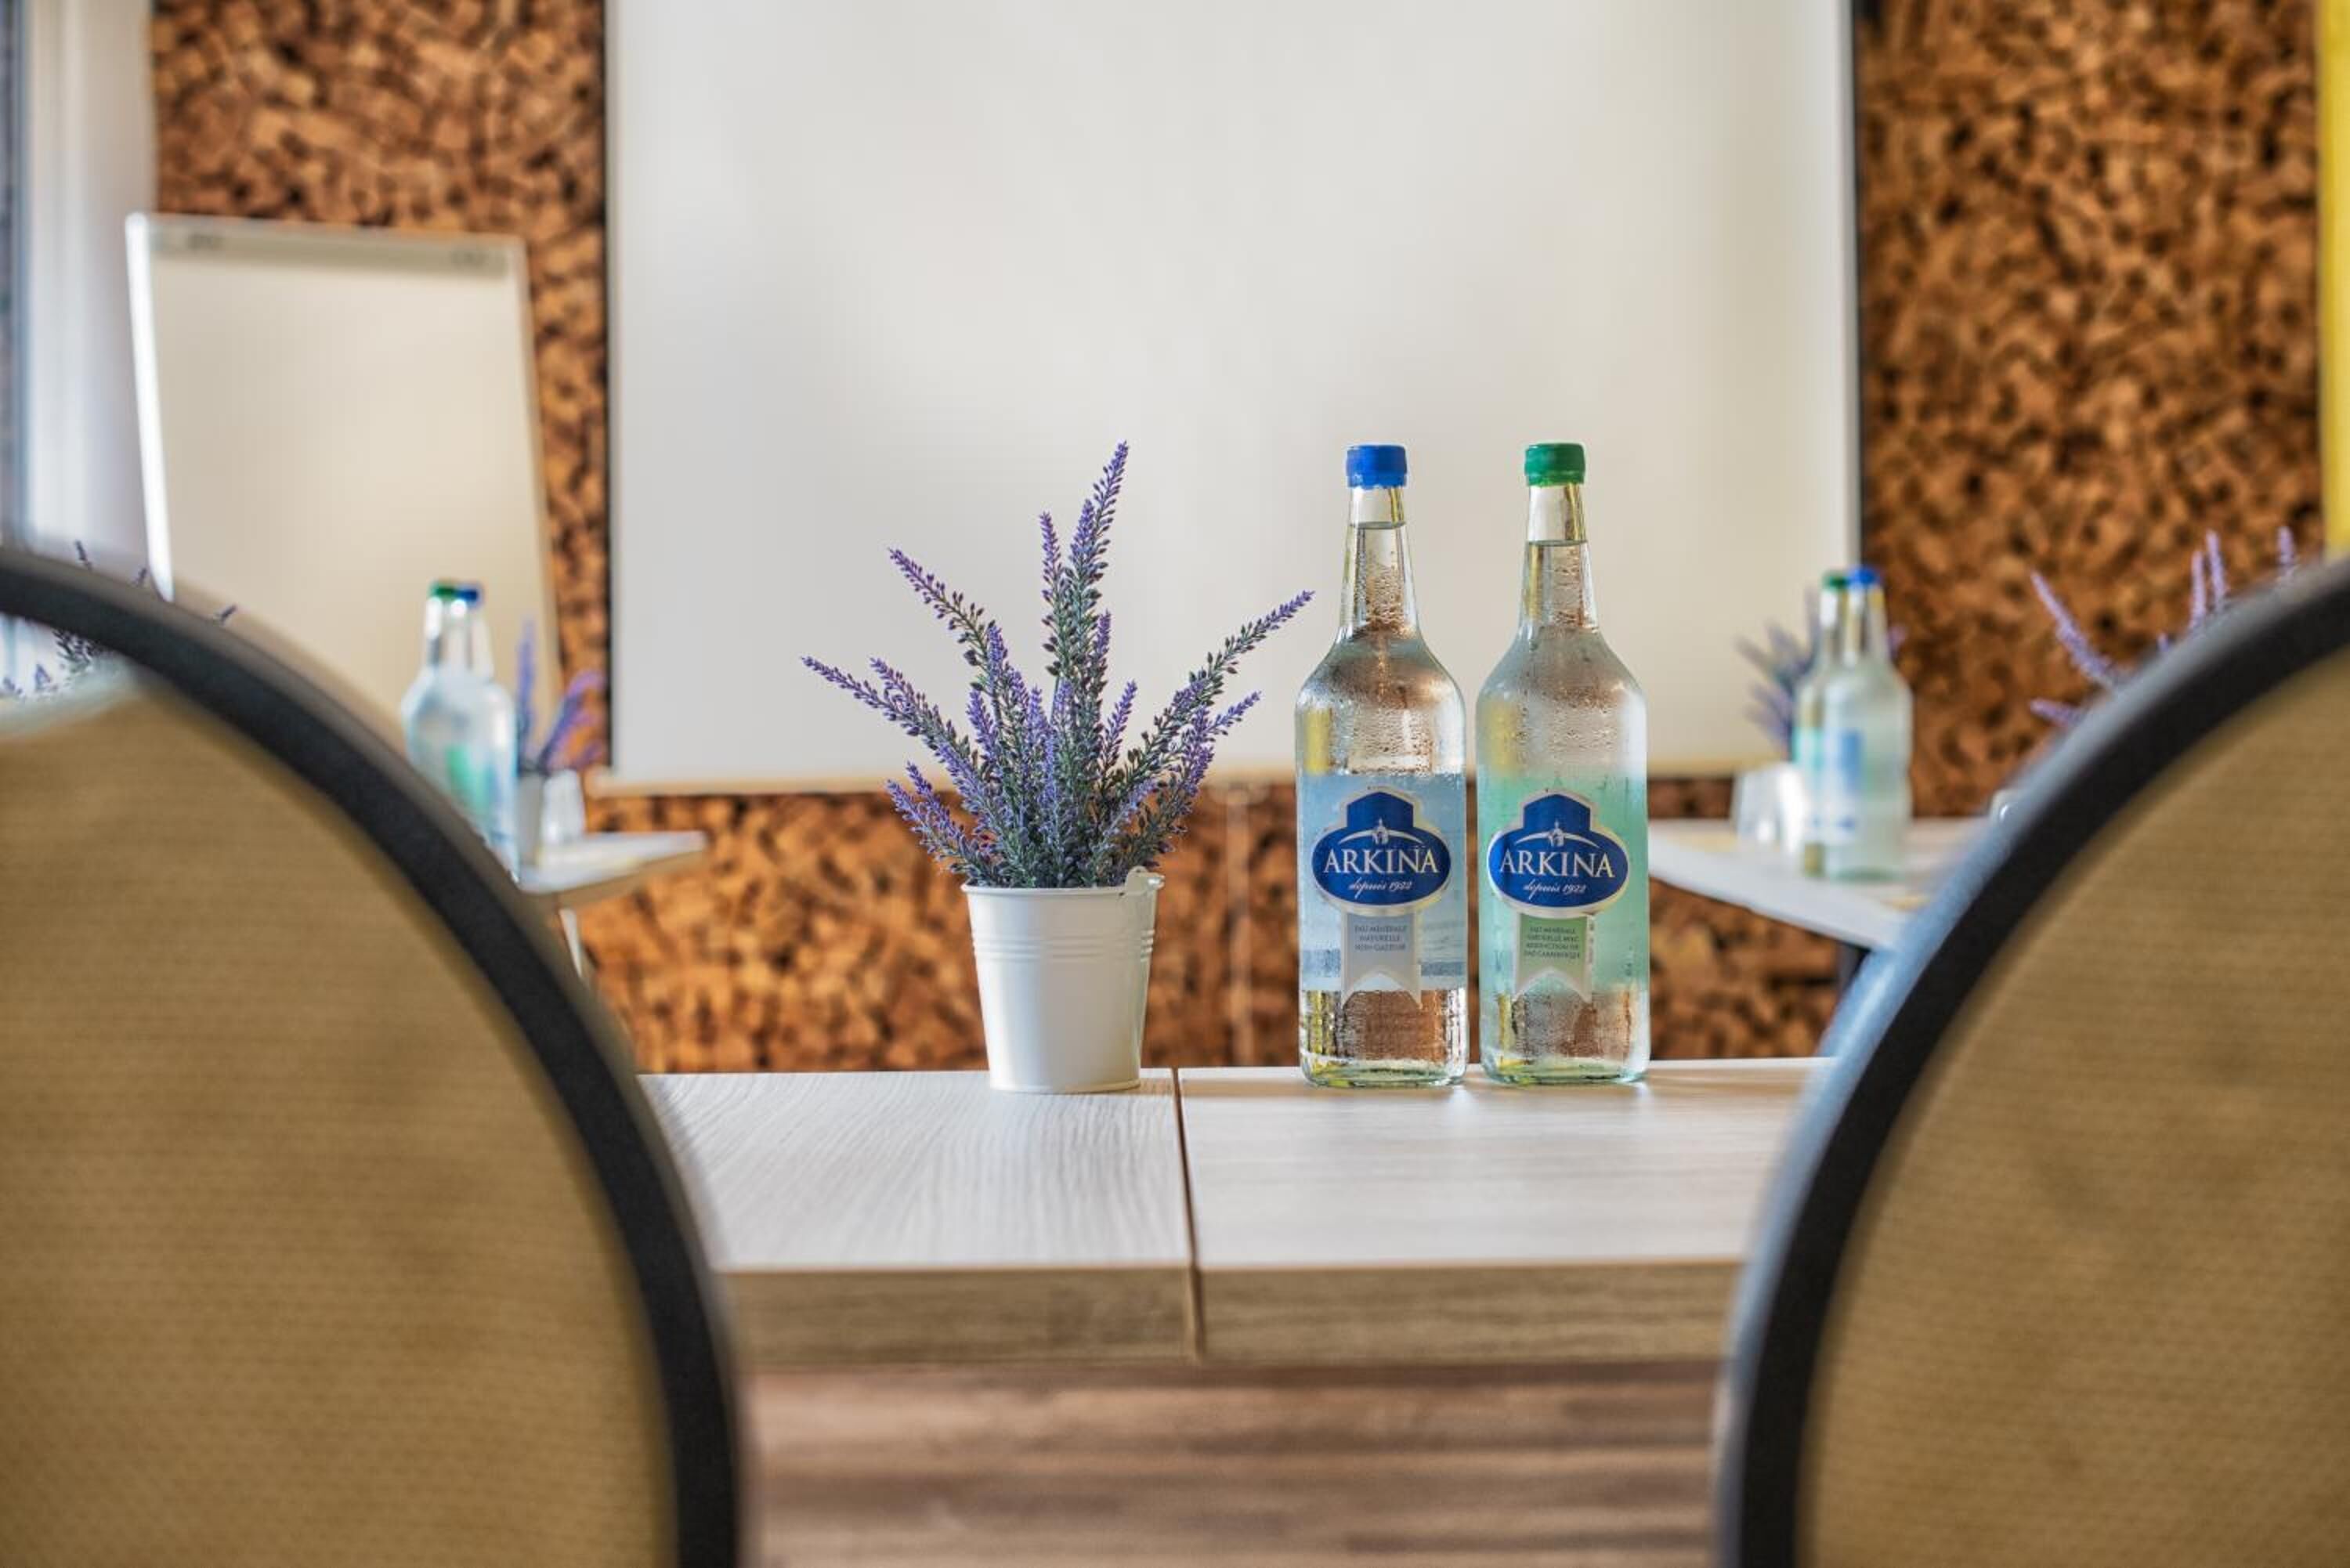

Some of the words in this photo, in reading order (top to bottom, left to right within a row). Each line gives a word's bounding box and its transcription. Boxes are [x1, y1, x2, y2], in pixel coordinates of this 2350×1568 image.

[1323, 847, 1440, 873] ARKINA
[1499, 847, 1616, 878] ARKINA
[1348, 876, 1386, 899] depuis
[1522, 879, 1561, 900] depuis
